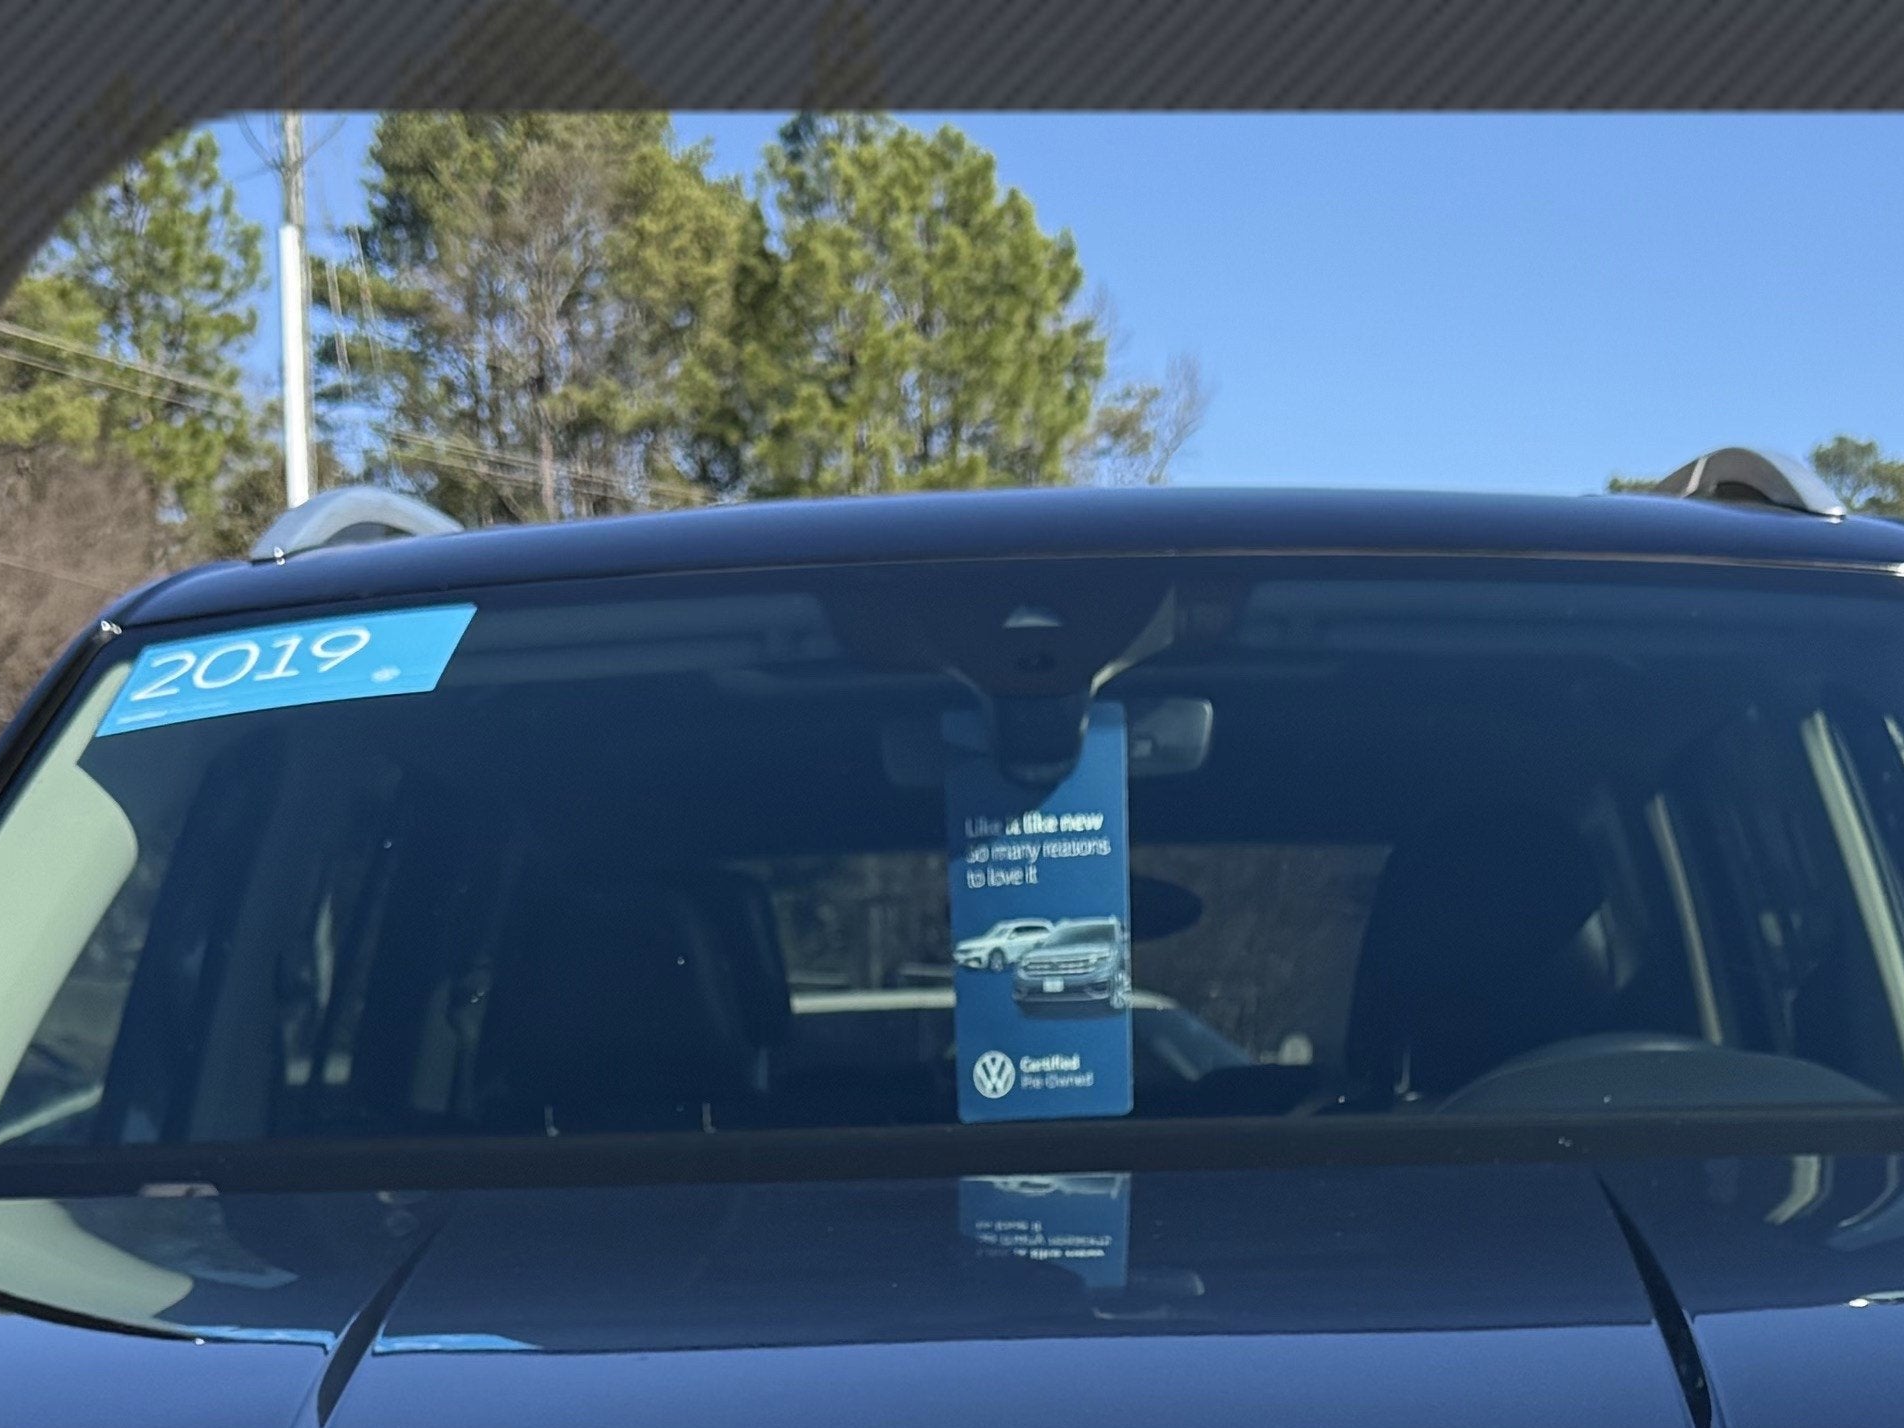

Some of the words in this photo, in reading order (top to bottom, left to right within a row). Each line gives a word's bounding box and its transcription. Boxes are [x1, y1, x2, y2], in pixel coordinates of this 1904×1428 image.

[130, 626, 371, 701] 2019
[1023, 810, 1058, 834] like
[1060, 812, 1104, 832] new
[991, 842, 1041, 864] many
[1043, 836, 1111, 858] reasons
[967, 868, 985, 889] to
[987, 865, 1024, 887] love
[1025, 864, 1038, 885] it
[1019, 1053, 1080, 1073] Certified
